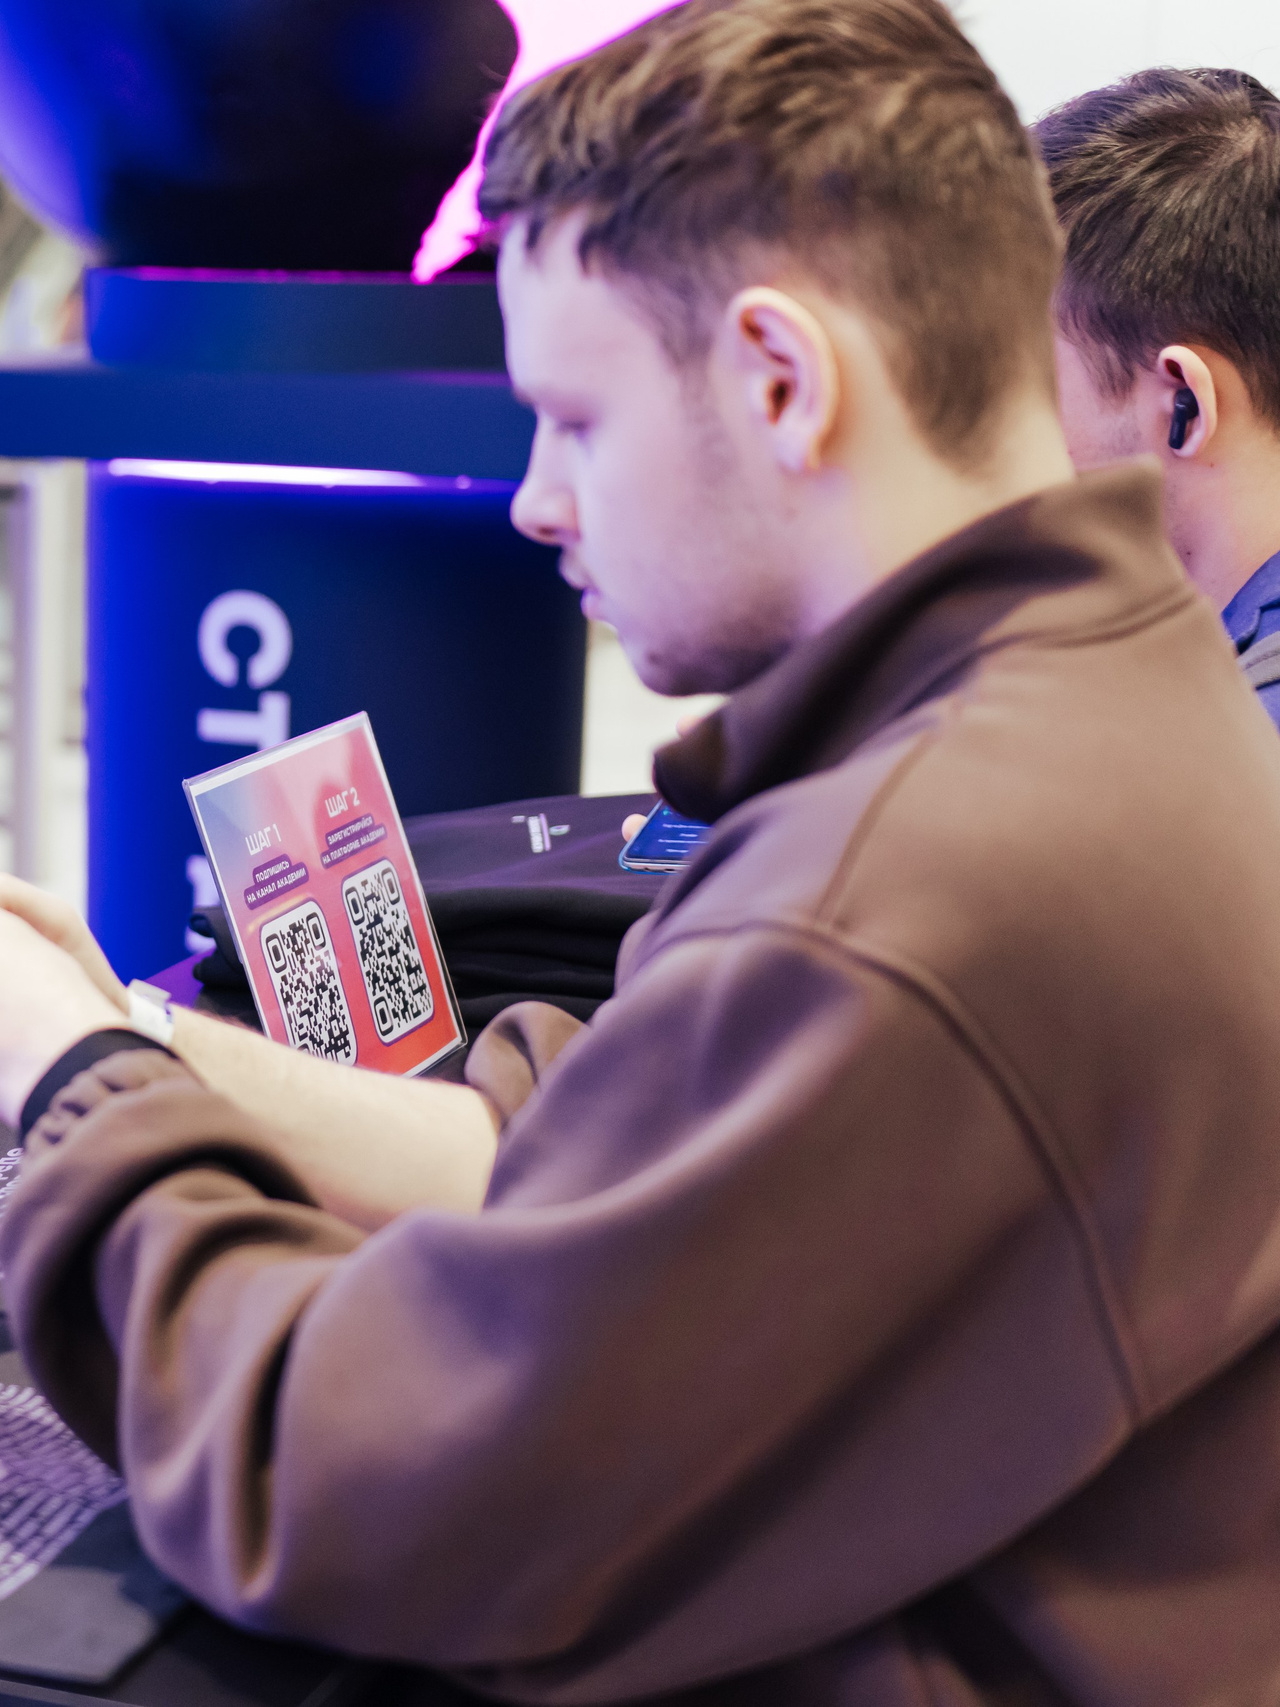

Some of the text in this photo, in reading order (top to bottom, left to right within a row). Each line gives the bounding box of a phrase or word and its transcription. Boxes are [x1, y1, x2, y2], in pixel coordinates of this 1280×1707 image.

[323, 786, 361, 818] ШАГ 2
[244, 823, 282, 856] ШАГ 1
[322, 826, 386, 865] НА ПЛАТФОРМЕ АКАДЕМИИ
[246, 867, 307, 904] НА КАНАЛ АКАДЕМИИ
[255, 860, 290, 883] ПОДПИШИСЬ
